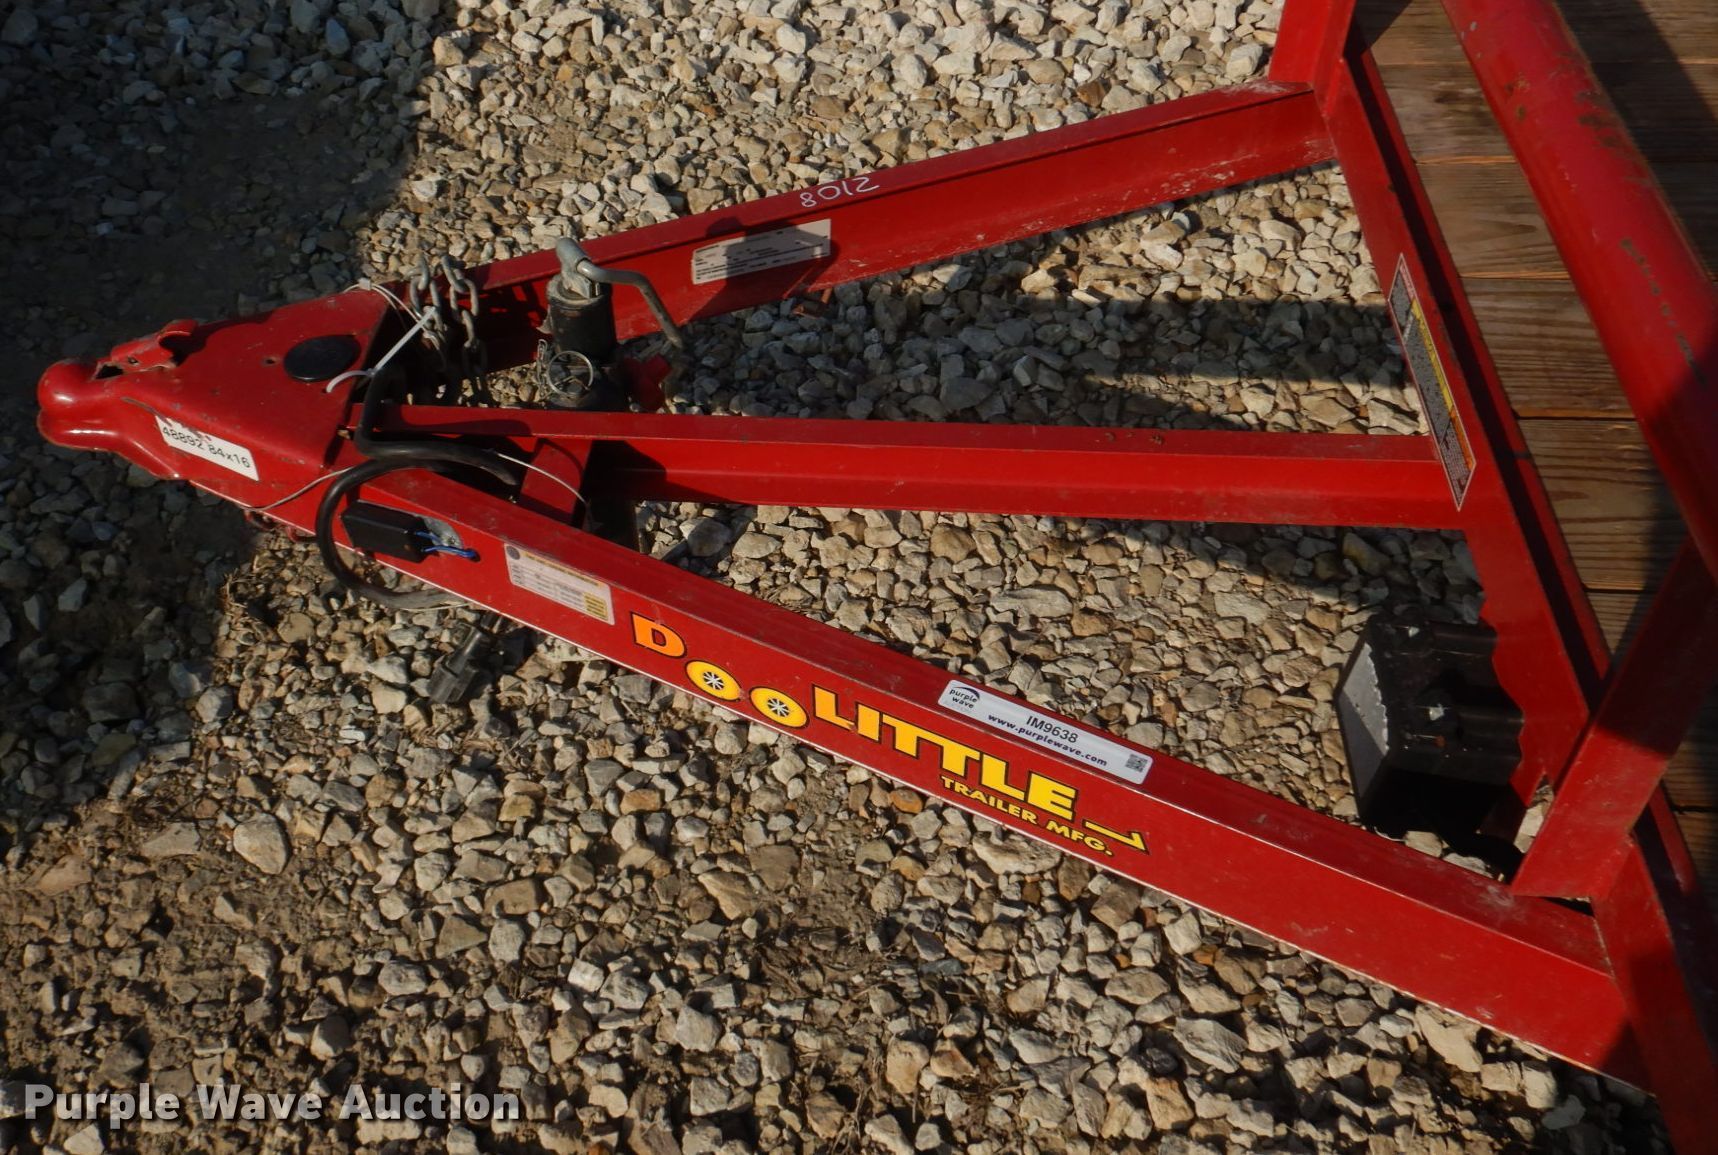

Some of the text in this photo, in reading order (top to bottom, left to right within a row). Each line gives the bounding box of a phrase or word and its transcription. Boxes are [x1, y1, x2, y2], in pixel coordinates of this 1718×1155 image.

[949, 688, 978, 703] purple
[952, 696, 975, 709] wave
[987, 714, 1108, 767] www.purplewave.com
[1026, 715, 1079, 743] IM9638
[940, 775, 1114, 857] TRAILER MFG.
